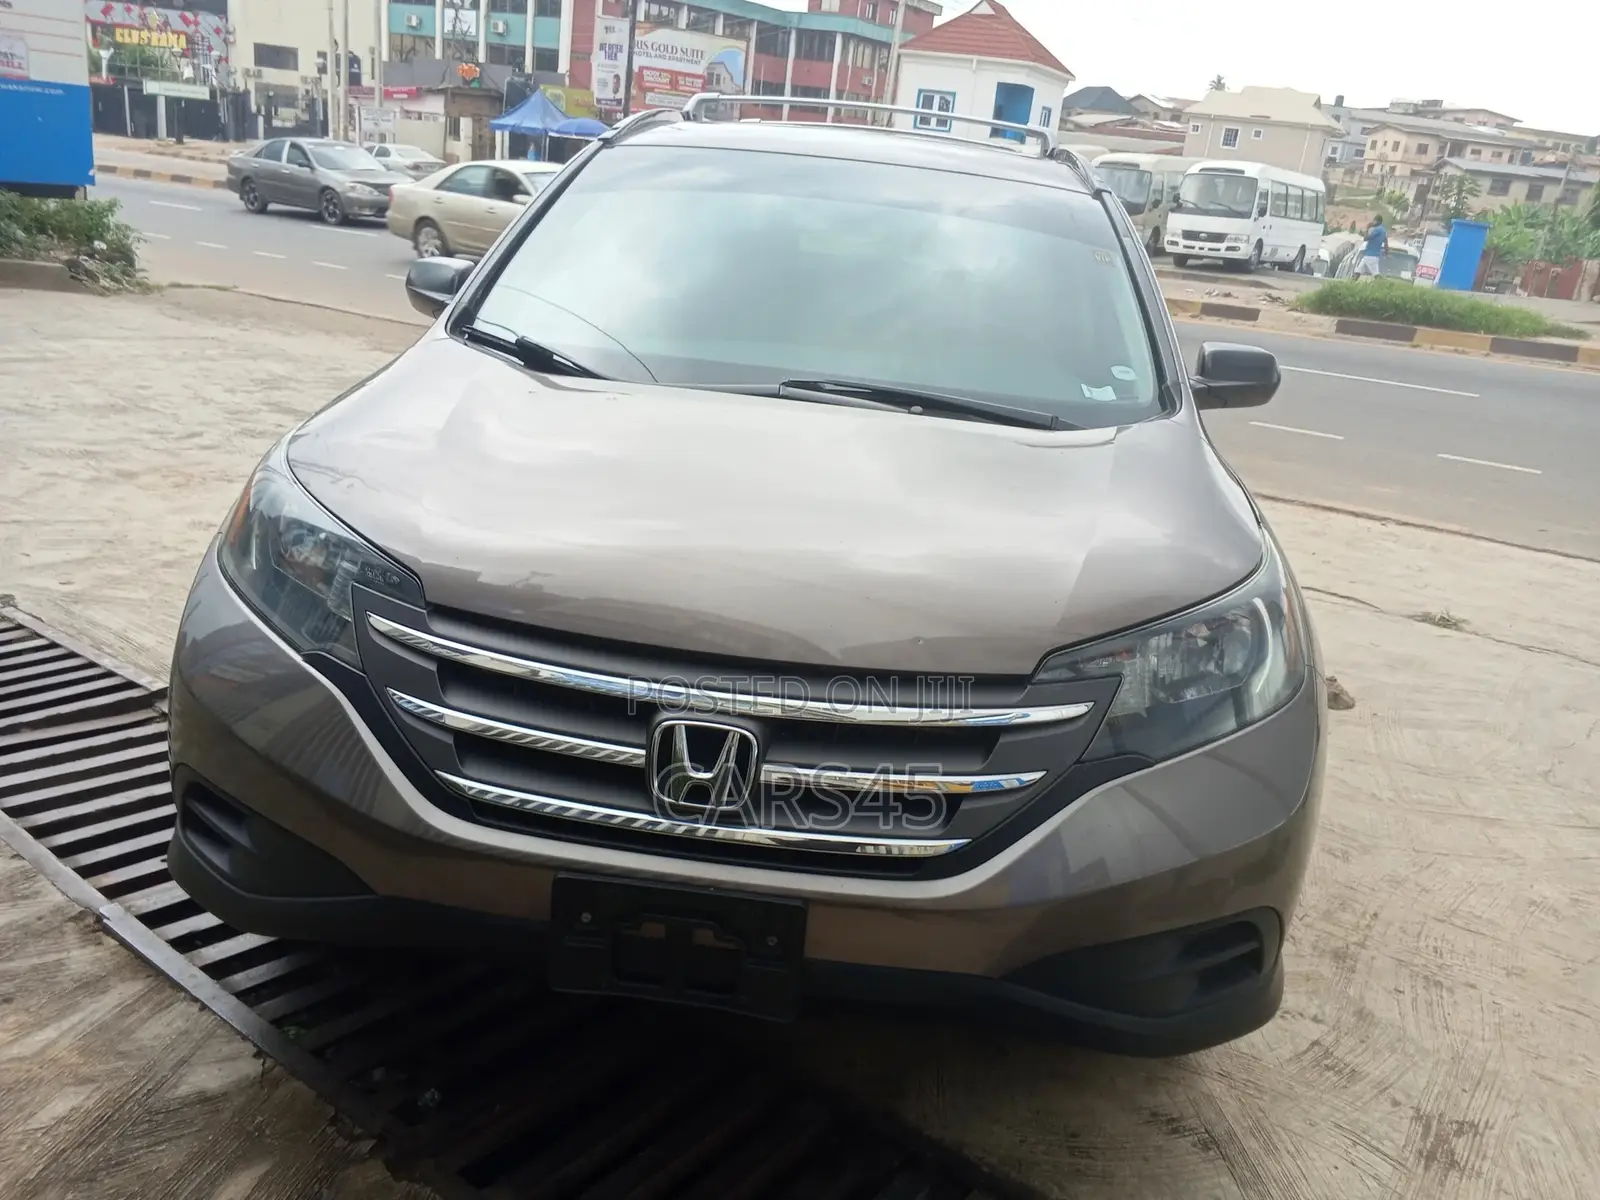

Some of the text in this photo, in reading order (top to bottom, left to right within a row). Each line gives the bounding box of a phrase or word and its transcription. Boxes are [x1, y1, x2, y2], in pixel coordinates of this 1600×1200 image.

[651, 41, 678, 55] GOLD
[680, 47, 706, 60] SUITE
[668, 55, 701, 65] APARTMENT
